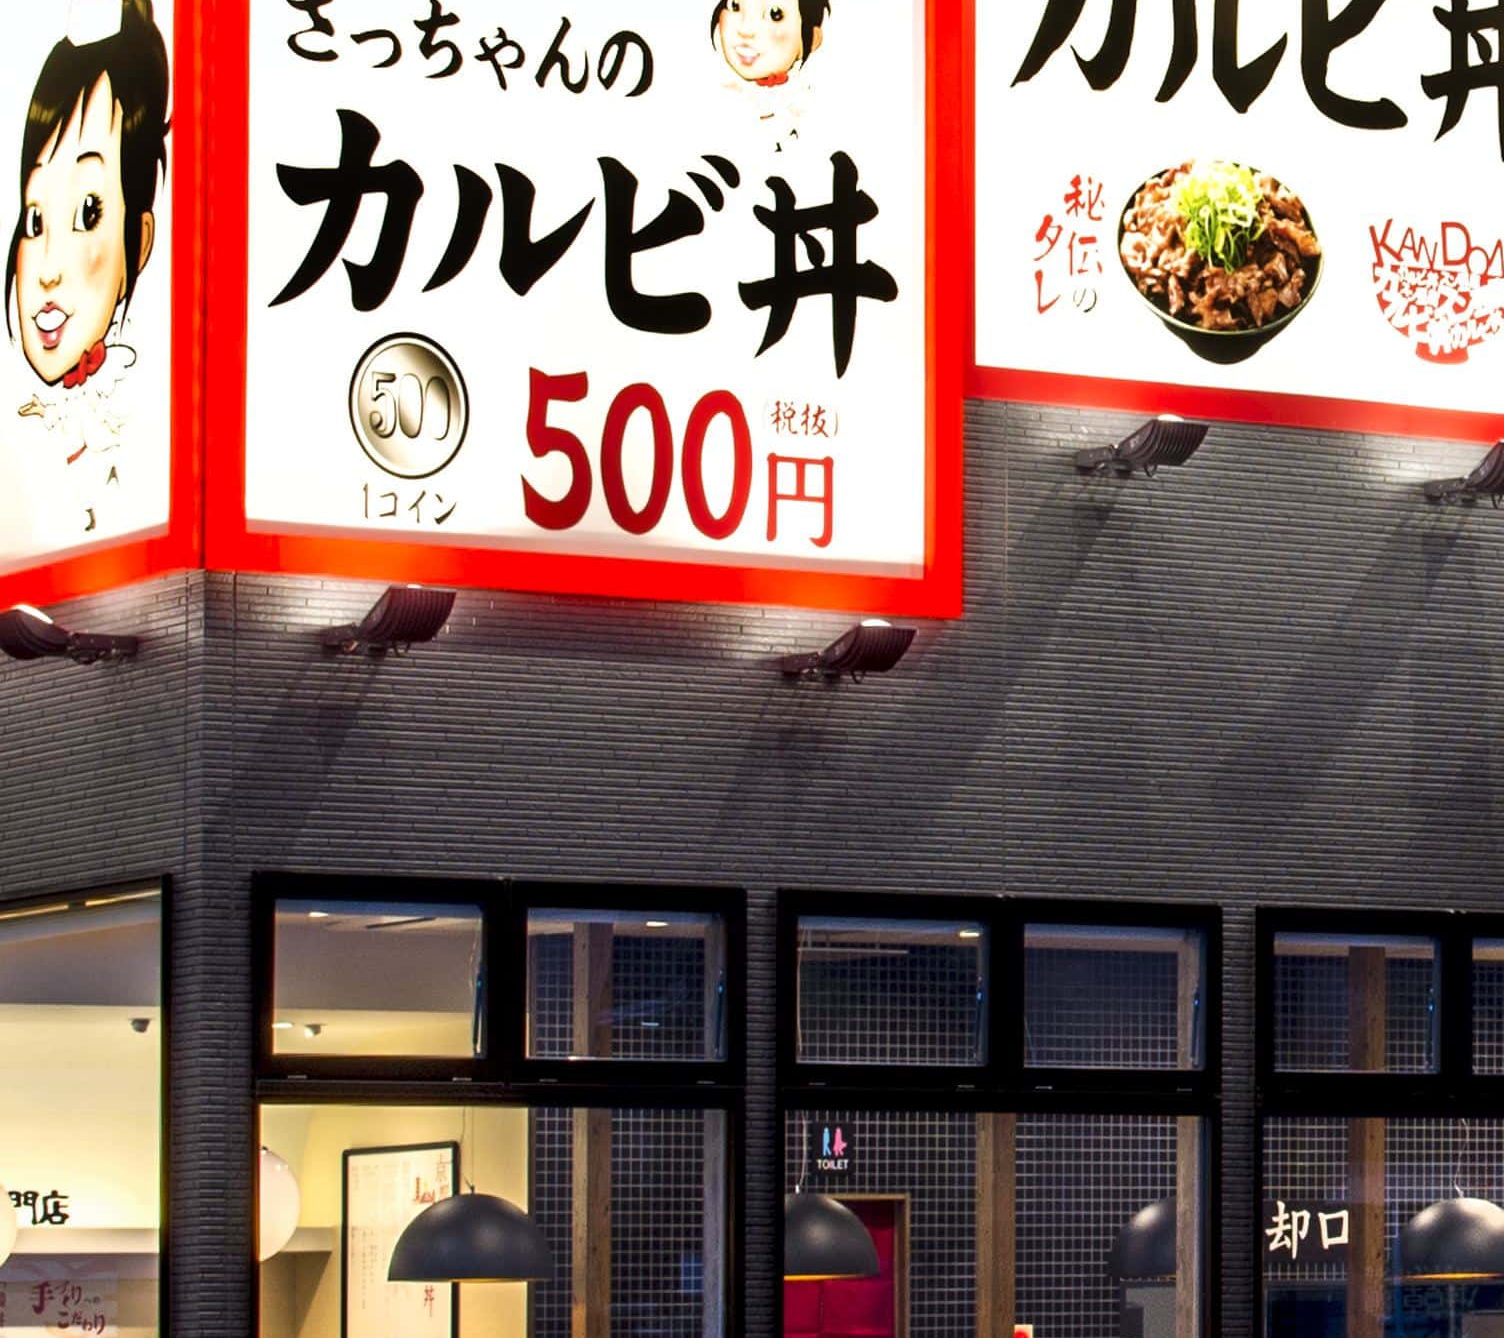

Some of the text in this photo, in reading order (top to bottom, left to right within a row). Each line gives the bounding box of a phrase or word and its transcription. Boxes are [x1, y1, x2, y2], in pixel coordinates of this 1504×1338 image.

[267, 108, 899, 380] カルビ丼
[362, 483, 457, 526] 1コイン
[817, 1159, 848, 1170] TOILET
